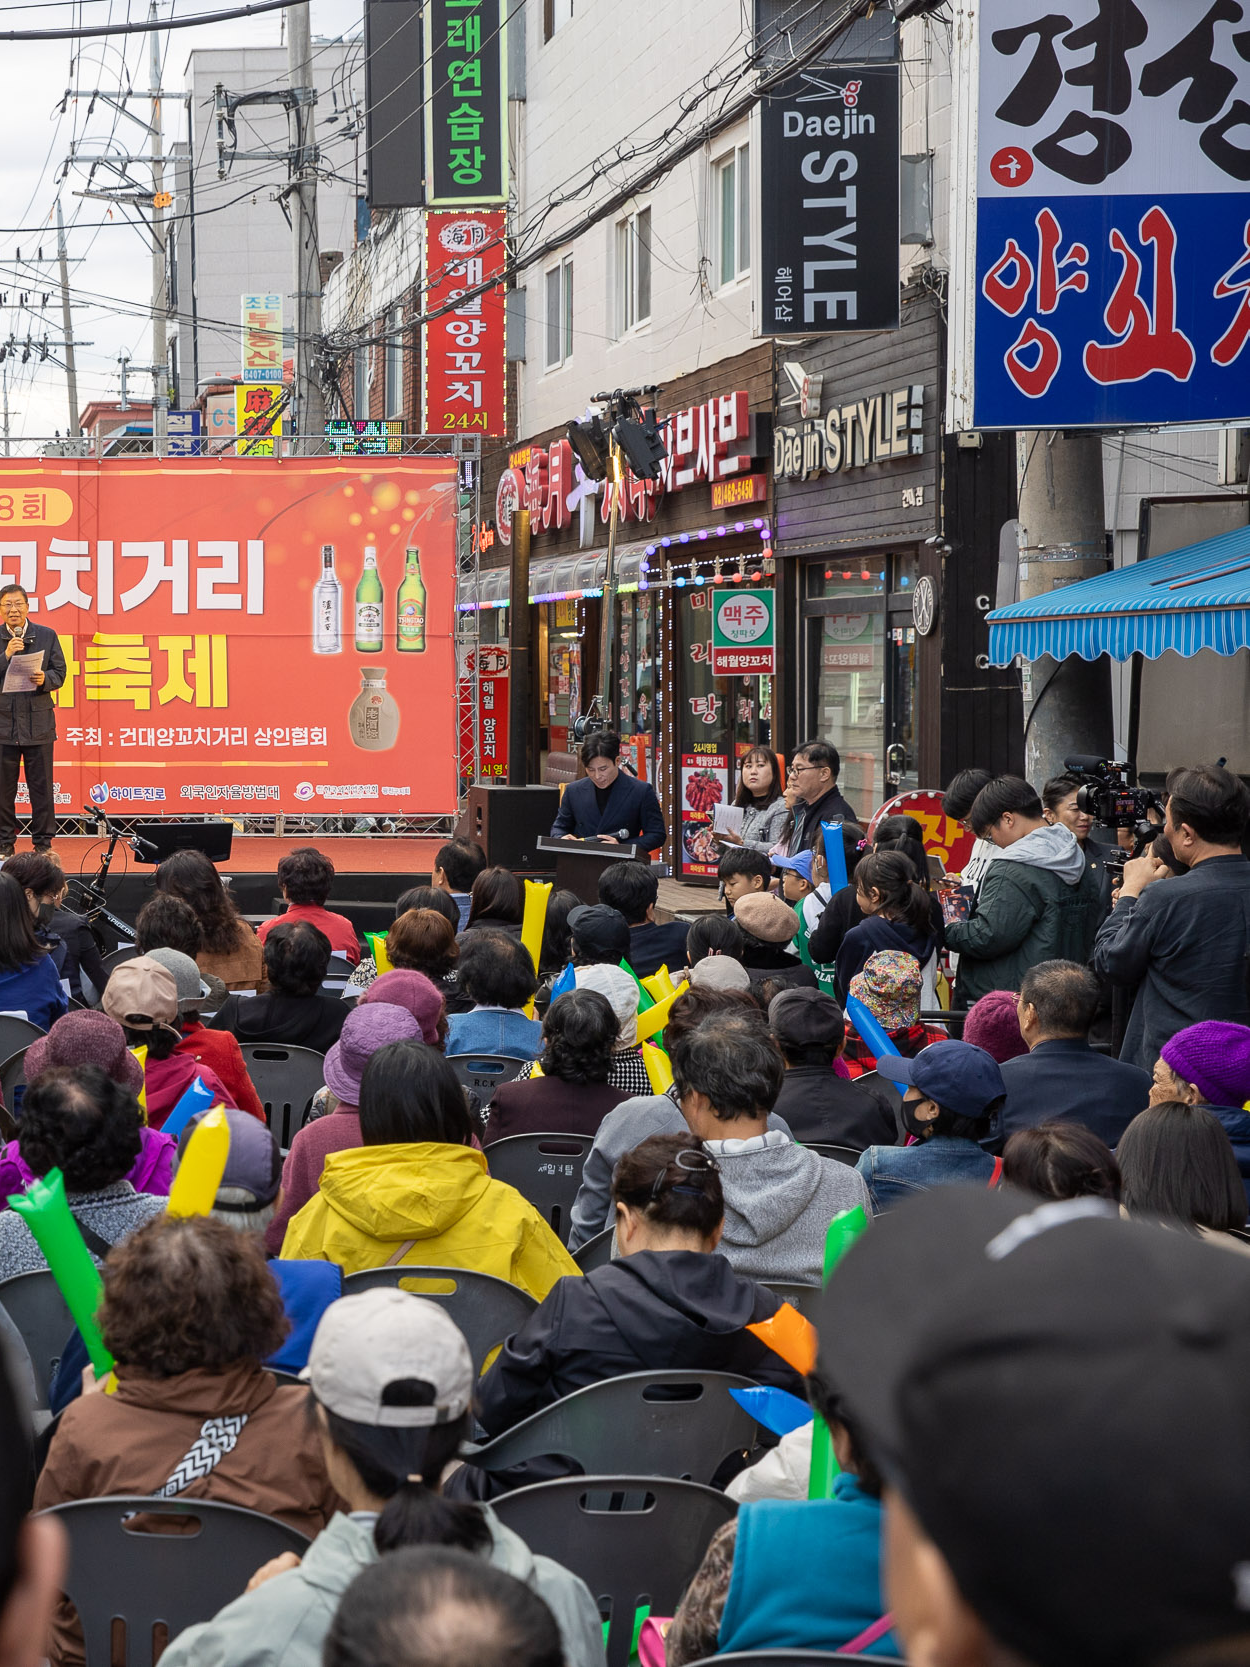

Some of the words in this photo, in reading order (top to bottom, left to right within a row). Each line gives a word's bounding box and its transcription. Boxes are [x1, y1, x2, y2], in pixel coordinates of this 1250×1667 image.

[445, 0, 486, 185] 래연습장
[783, 108, 876, 139] Daejin
[447, 226, 486, 245] 海月
[801, 150, 858, 323] STYLE
[245, 295, 280, 310] 조은
[774, 266, 793, 322] 헤어샵
[246, 312, 280, 367] 부동산
[444, 257, 487, 409] 해월양꼬치
[244, 369, 282, 379] 6407-0100
[443, 411, 488, 430] 24시
[774, 421, 821, 480] Daejin
[825, 389, 910, 474] STYLE
[714, 479, 754, 506] 02)462-5450
[398, 617, 424, 625] TSINGTAO
[723, 605, 764, 626] 맥주
[716, 654, 772, 668] 해월양꼬치
[482, 681, 495, 710] 해월
[65, 727, 103, 748] 주최
[119, 726, 248, 748] 건대양꼬치거리
[254, 725, 328, 747] 상인협회
[483, 718, 497, 759] 양꼬치
[693, 743, 717, 754] 24시영업
[109, 786, 166, 800] 하이트진로
[180, 785, 280, 800] 외국인자율방범대
[111, 917, 136, 938] PIGEON
